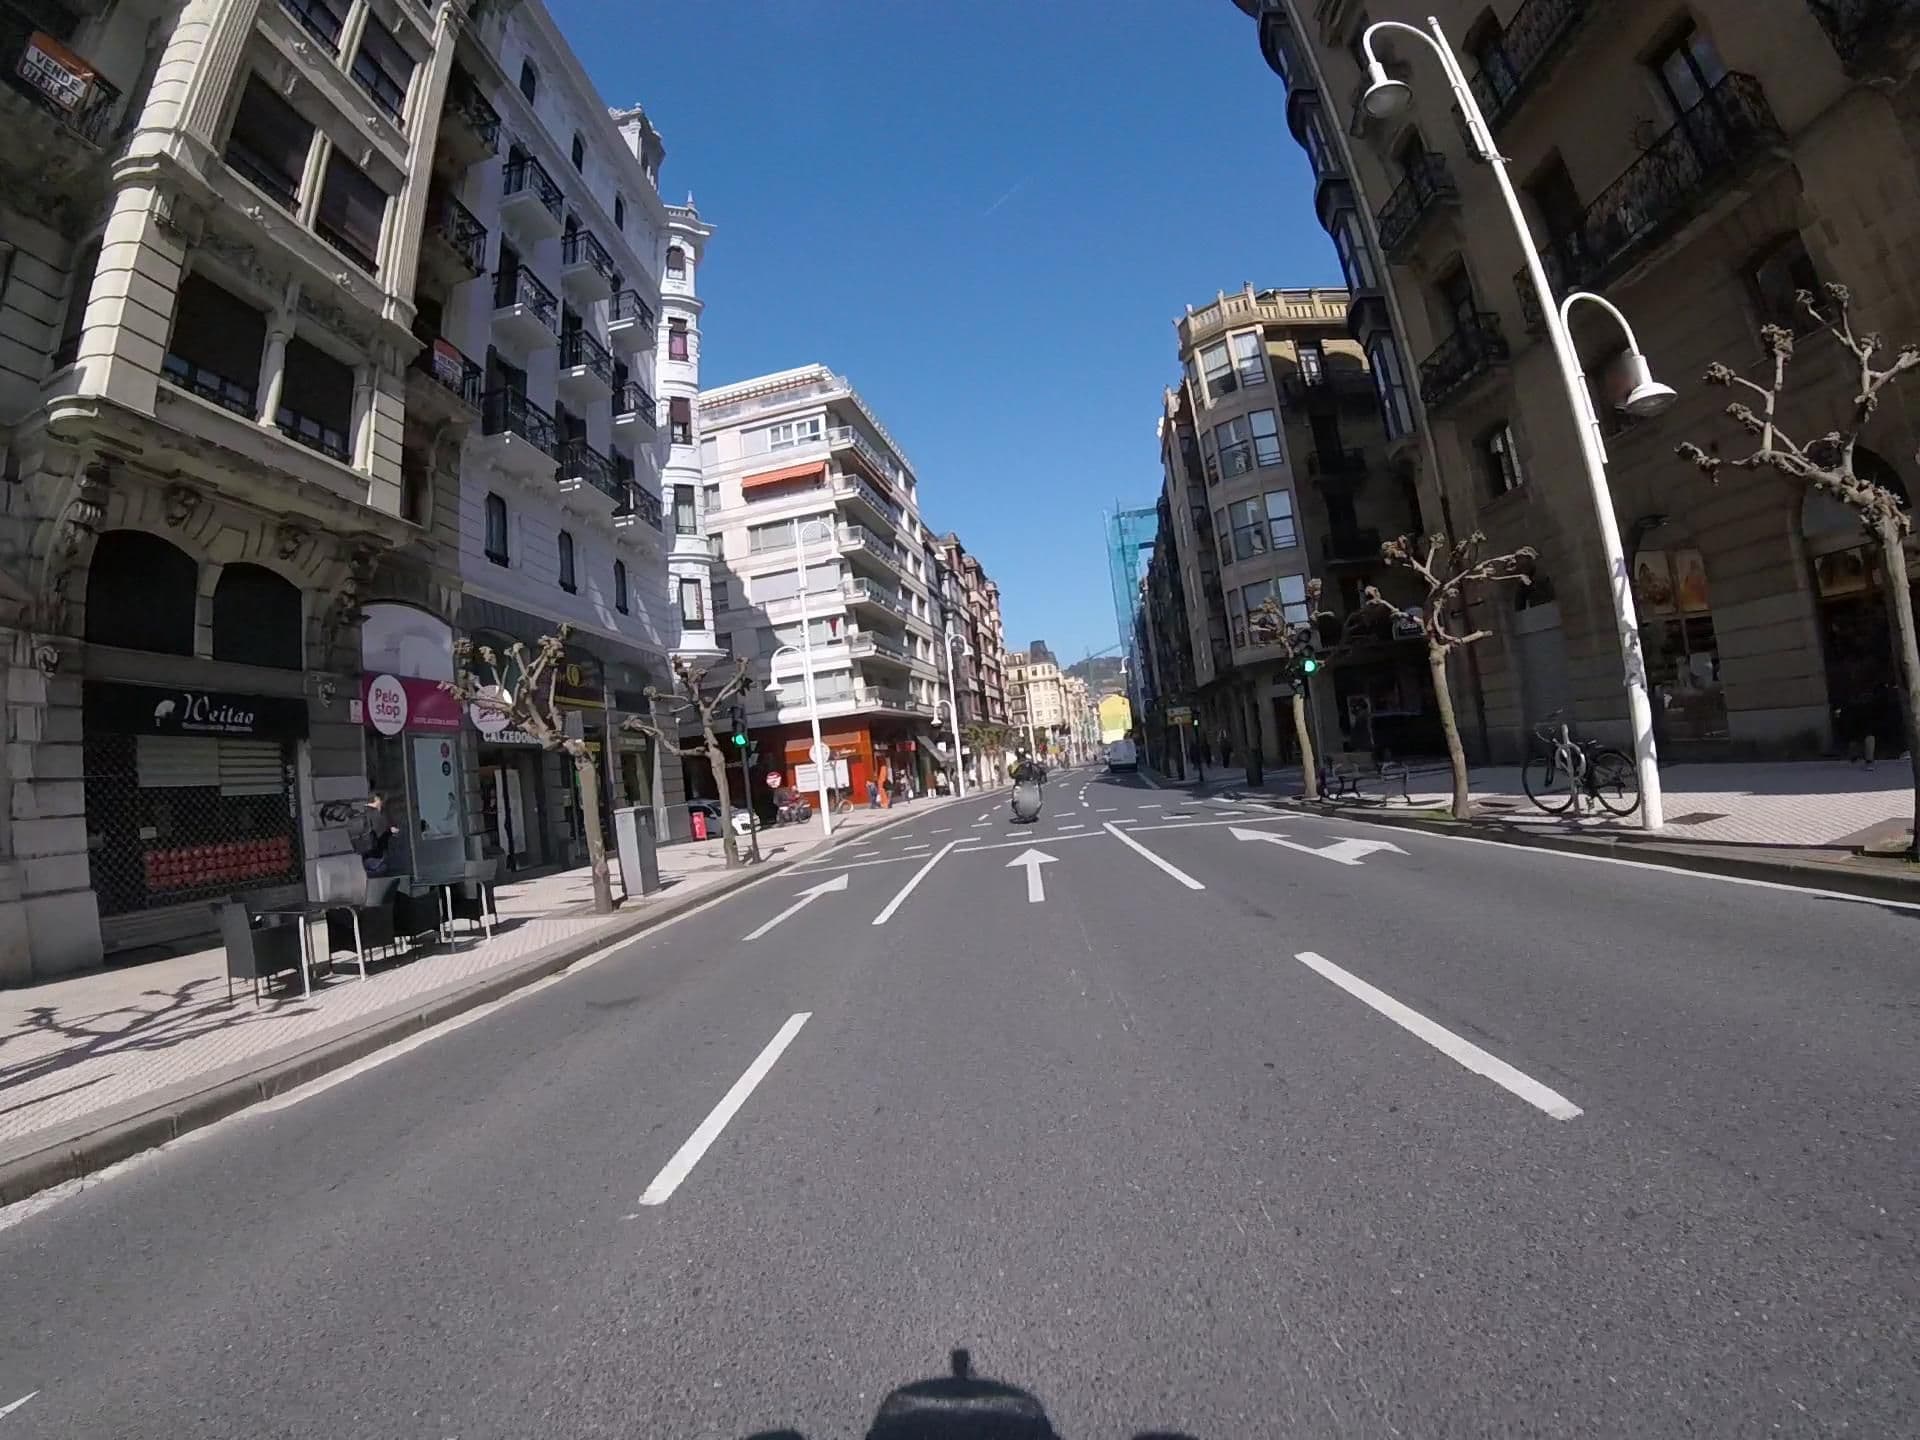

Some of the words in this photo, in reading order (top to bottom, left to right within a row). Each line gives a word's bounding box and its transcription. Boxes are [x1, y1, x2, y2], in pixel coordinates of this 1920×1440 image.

[36, 51, 80, 90] VENDE
[375, 687, 400, 703] Pelo
[183, 693, 254, 724] Weitao
[375, 702, 401, 719] stop
[483, 730, 543, 744] CALZEDO
